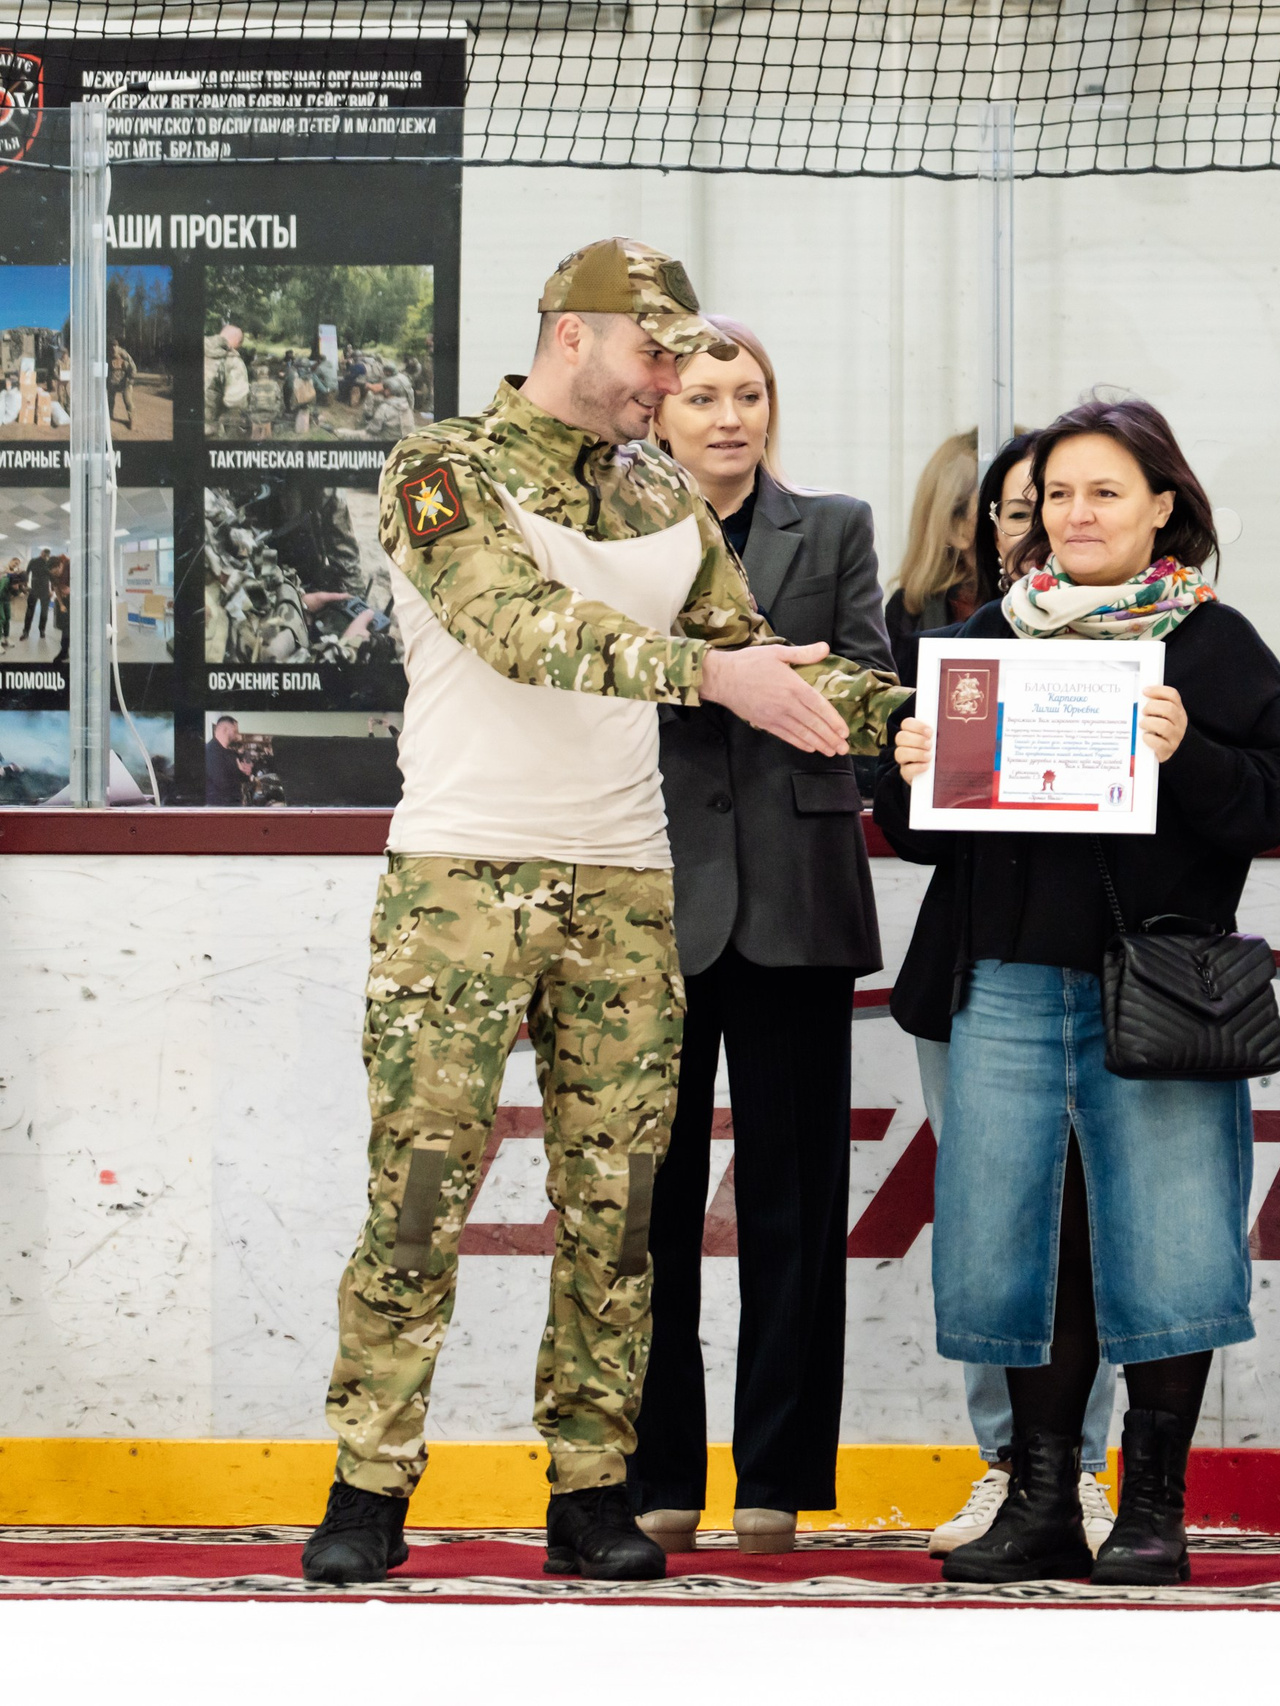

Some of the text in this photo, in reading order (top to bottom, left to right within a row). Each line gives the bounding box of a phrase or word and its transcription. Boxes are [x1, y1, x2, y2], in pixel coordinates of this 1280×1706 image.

[378, 93, 389, 110] И
[343, 117, 354, 135] И
[106, 214, 297, 249] АШИ ПРОЕКТЫ
[209, 450, 386, 471] ТАКТИЧЕСКАЯ МЕДИЦИНА
[5, 671, 66, 691] ПОМОЩЬ
[208, 672, 322, 691] ОБУЧЕНИЕ БПЛА
[1024, 682, 1121, 693] БЛАГОДАРНОСТЬ
